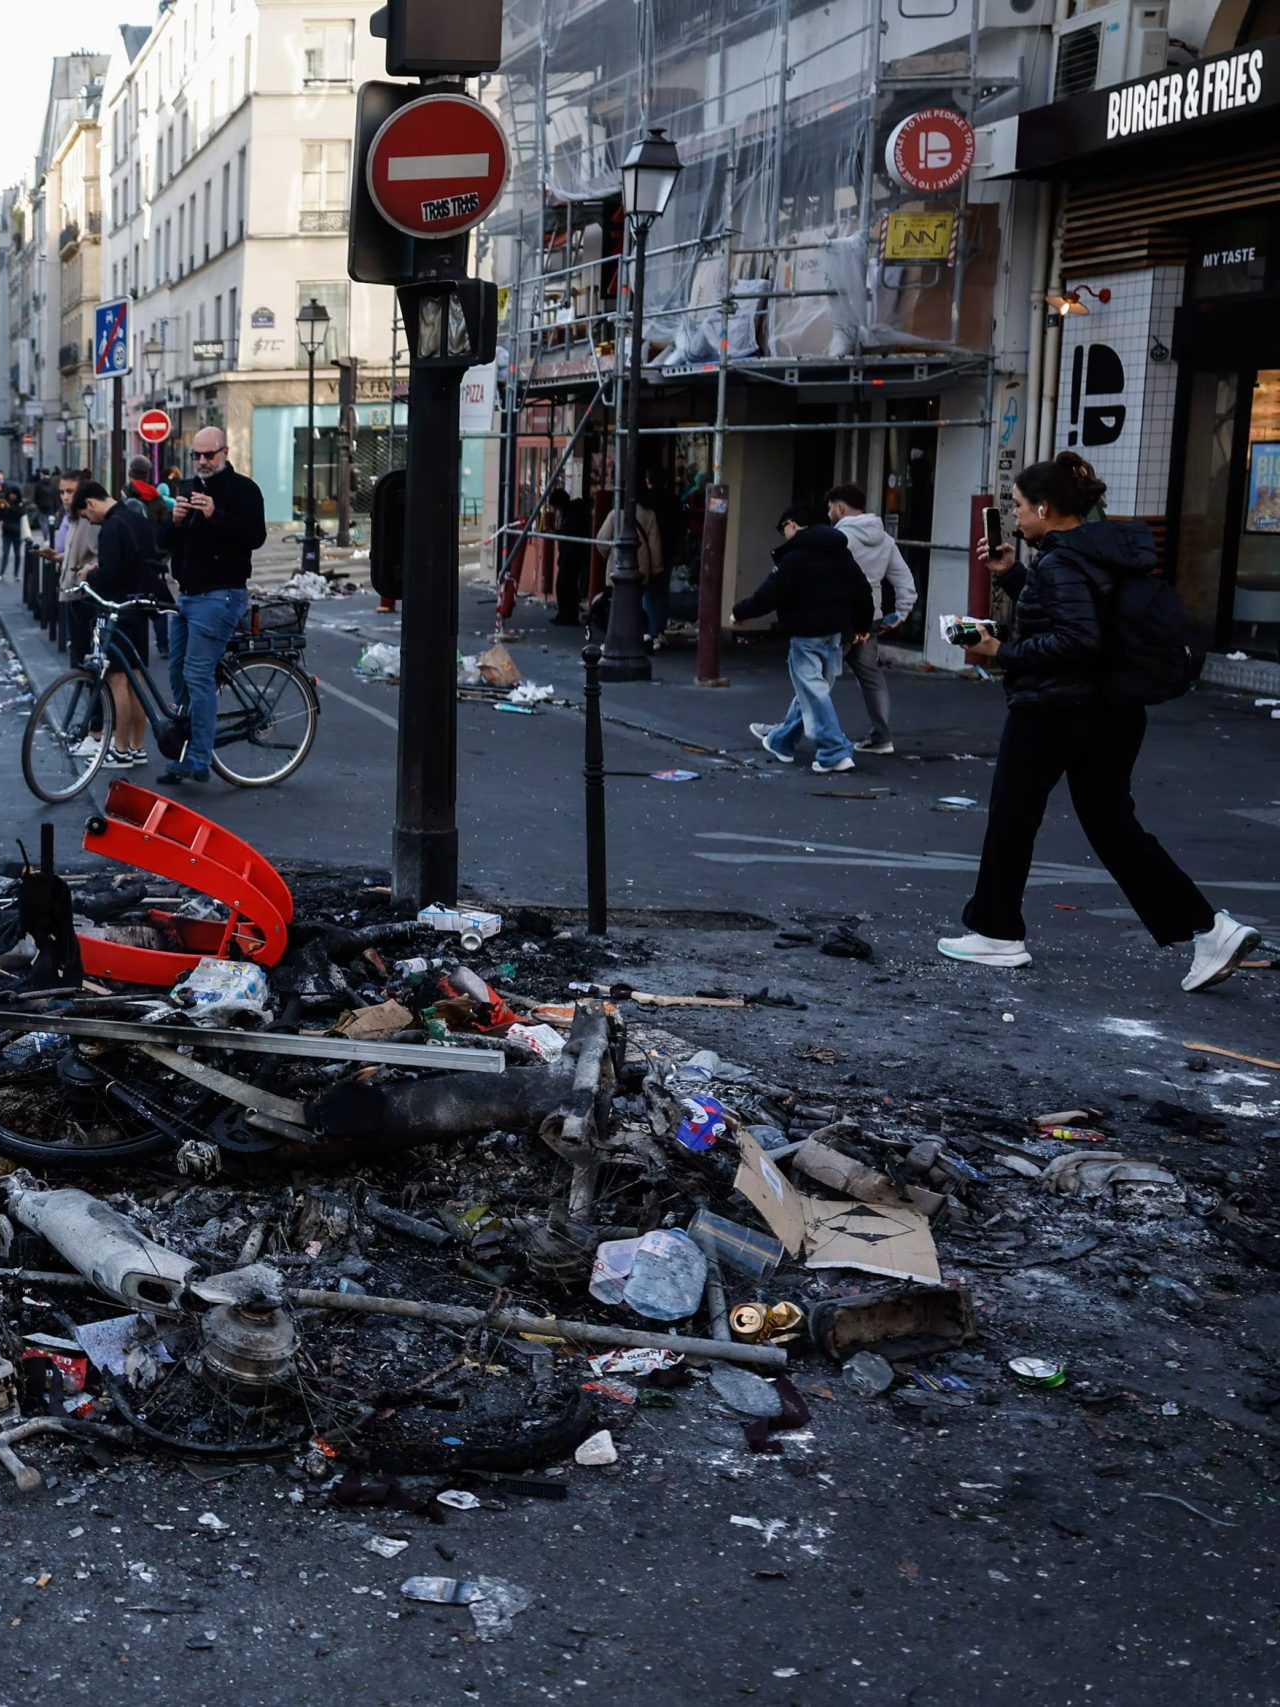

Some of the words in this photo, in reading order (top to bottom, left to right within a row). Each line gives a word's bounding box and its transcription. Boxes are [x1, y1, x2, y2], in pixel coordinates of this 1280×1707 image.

[1107, 73, 1183, 140] BURGER
[1184, 67, 1199, 120] &
[916, 110, 932, 123] THE
[1203, 251, 1221, 268] MY
[1222, 247, 1256, 265] TASTE
[465, 384, 484, 403] PIZZA
